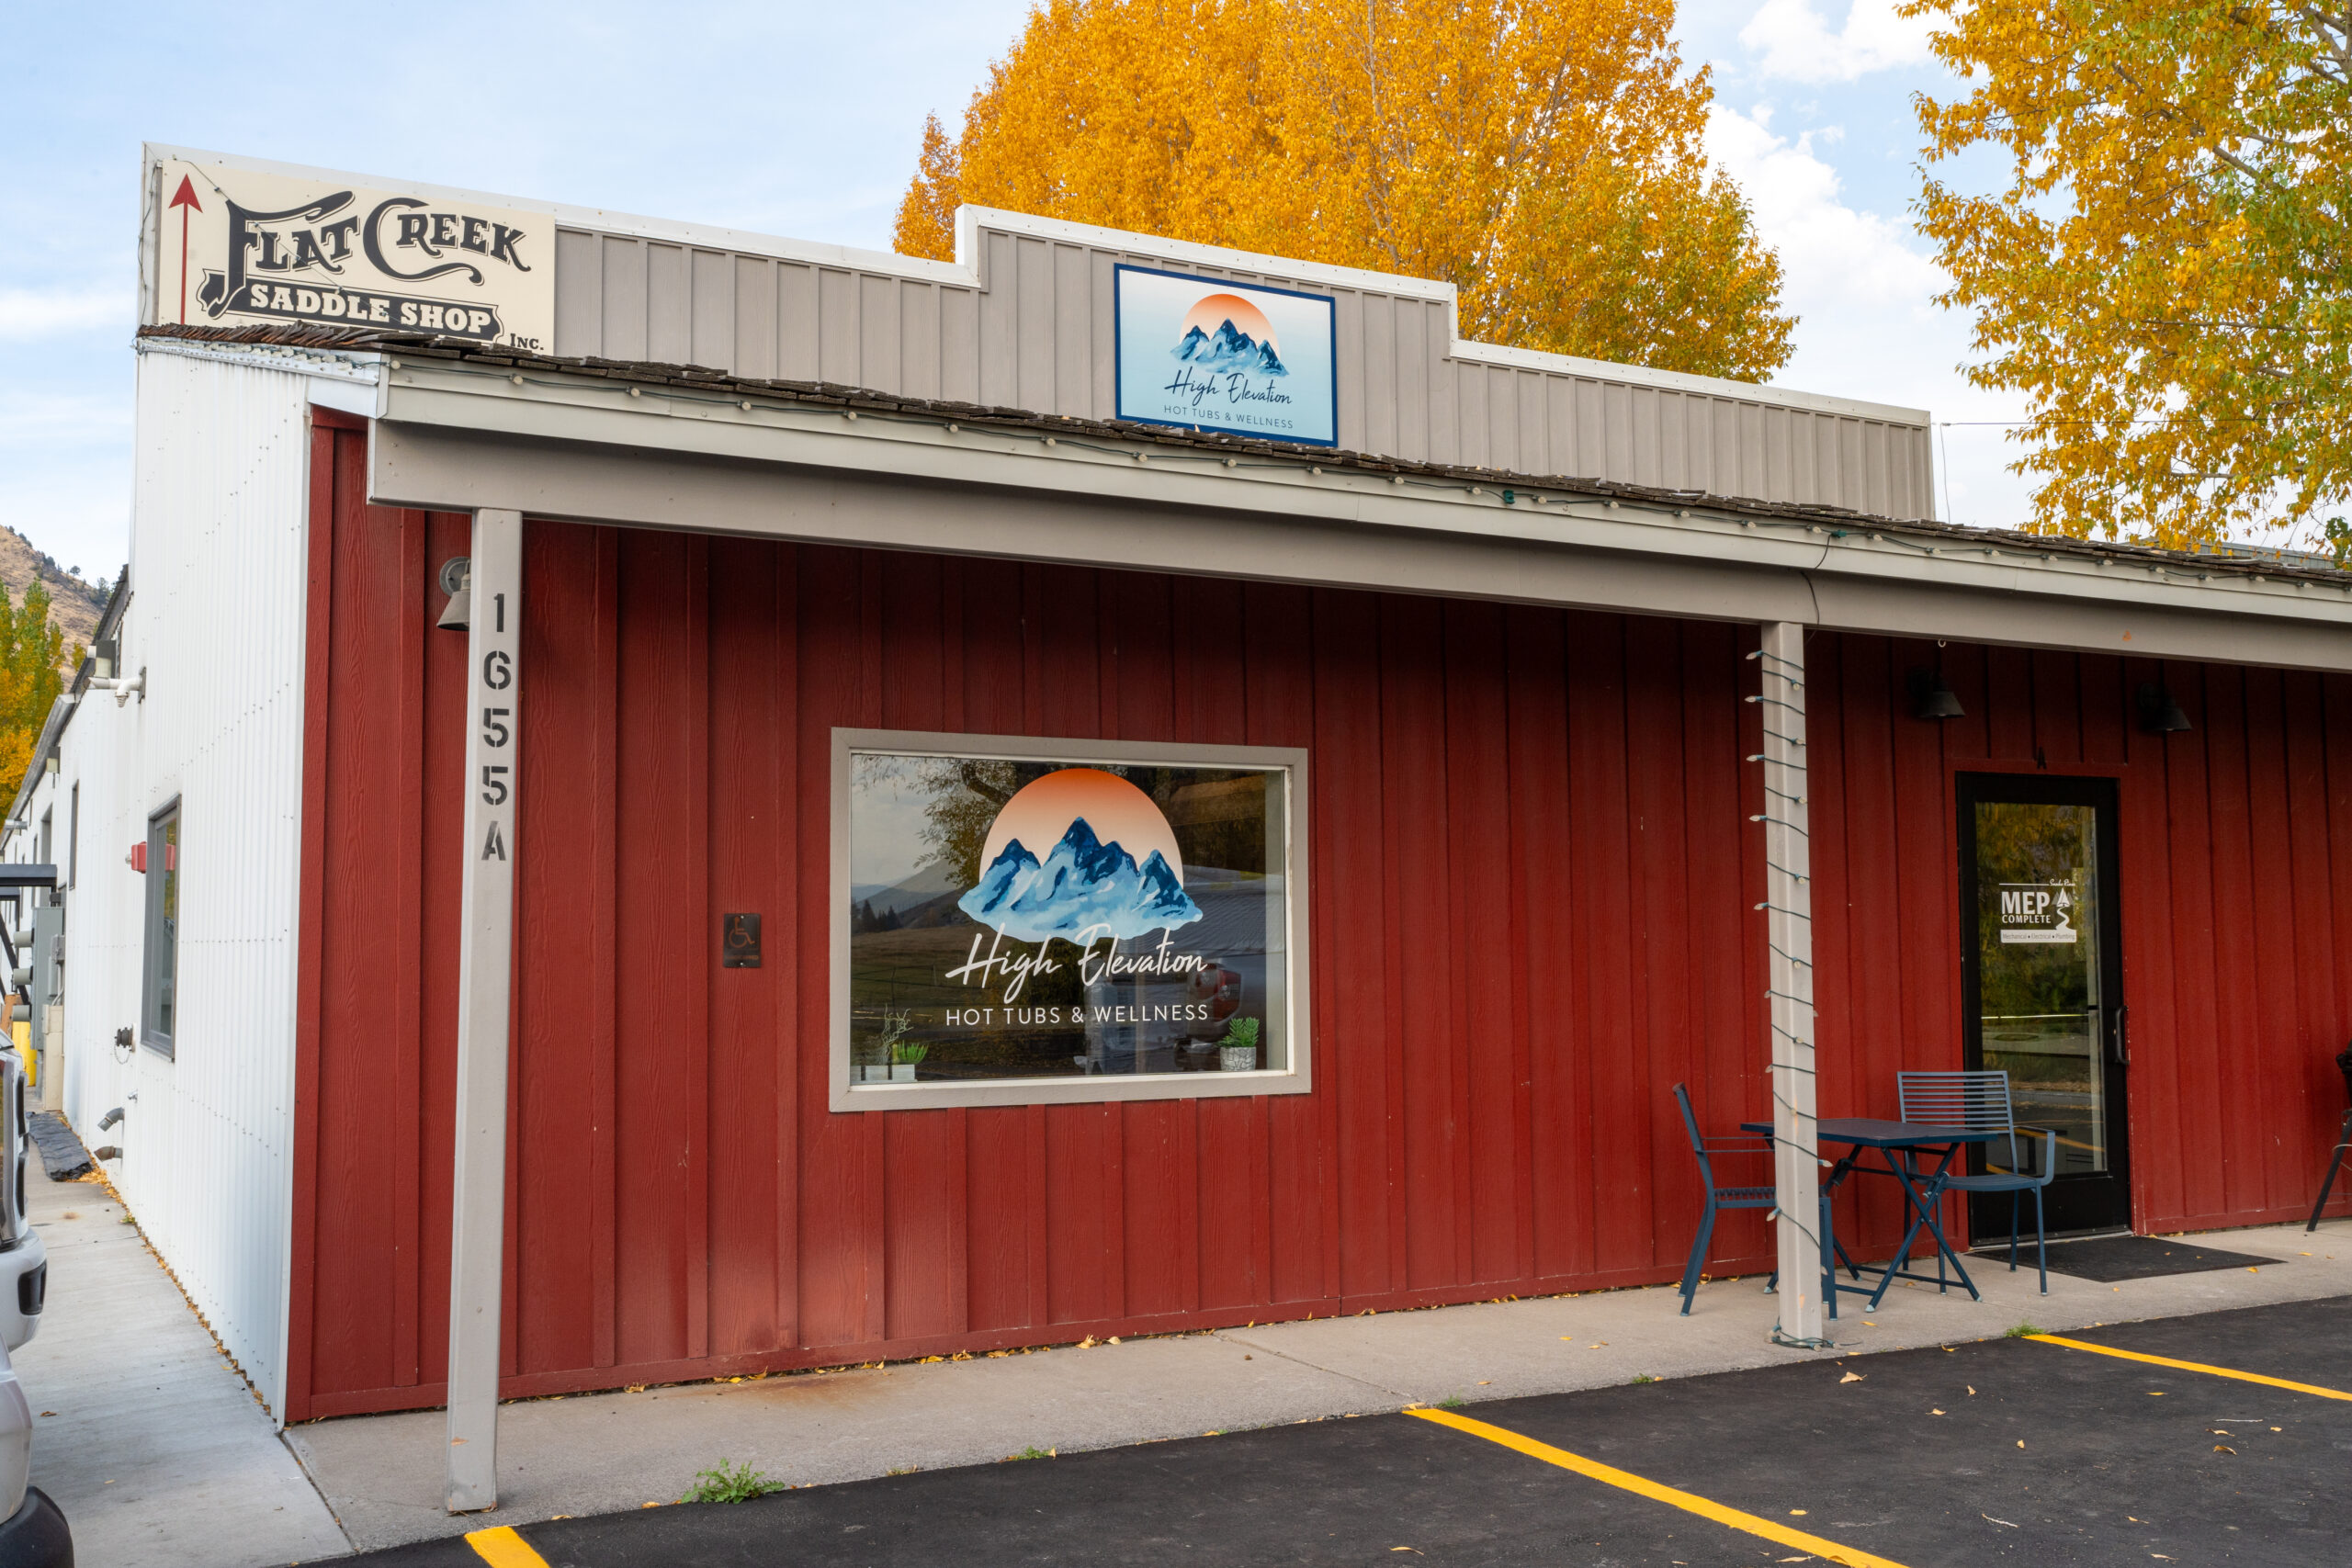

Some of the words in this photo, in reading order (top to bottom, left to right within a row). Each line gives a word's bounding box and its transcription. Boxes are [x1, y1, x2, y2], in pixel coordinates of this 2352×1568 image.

[207, 190, 359, 319] FLAT
[363, 197, 532, 286] CREEK
[250, 283, 390, 324] SADDLE
[401, 301, 492, 334] SHOP
[1164, 366, 1220, 407] High
[1227, 372, 1293, 404] Elevation
[1164, 404, 1188, 416] HOT
[1193, 408, 1220, 420] TUBS
[1225, 412, 1231, 422] &
[1237, 413, 1294, 429] WELLNESS
[2001, 891, 2051, 915] MEP
[2001, 914, 2052, 924] COMPLETE
[944, 921, 1063, 1004] High
[1074, 922, 1208, 987] Elevation
[945, 1009, 993, 1027] HOT
[1003, 1007, 1061, 1026] TUBS
[1071, 1006, 1084, 1023] &
[1094, 1004, 1208, 1022] WELLNESS
